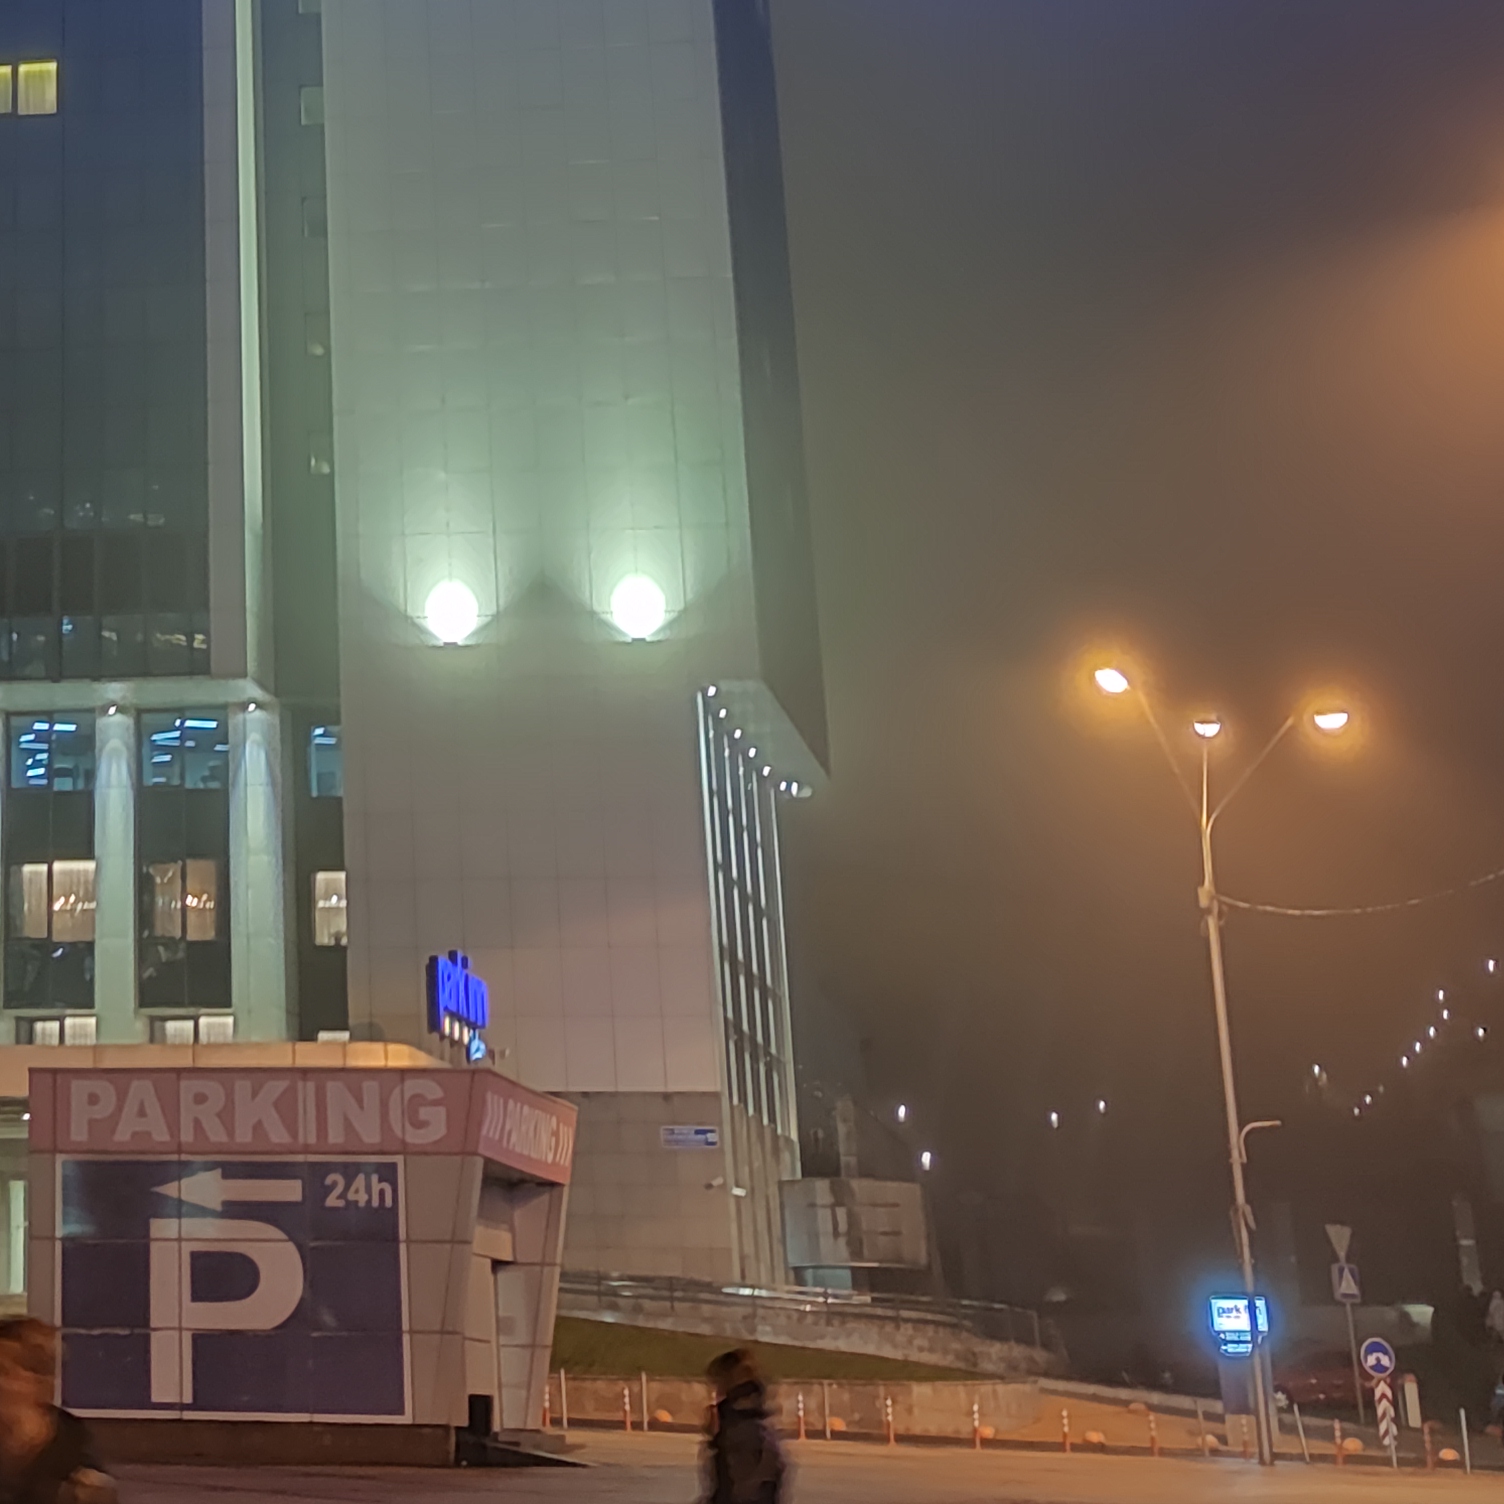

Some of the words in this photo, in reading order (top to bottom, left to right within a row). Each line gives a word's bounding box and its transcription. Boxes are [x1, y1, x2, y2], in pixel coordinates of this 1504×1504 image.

[69, 1079, 448, 1145] PARKING
[502, 1097, 558, 1165] PARKING
[324, 1173, 392, 1208] 24h
[150, 1218, 303, 1403] P
